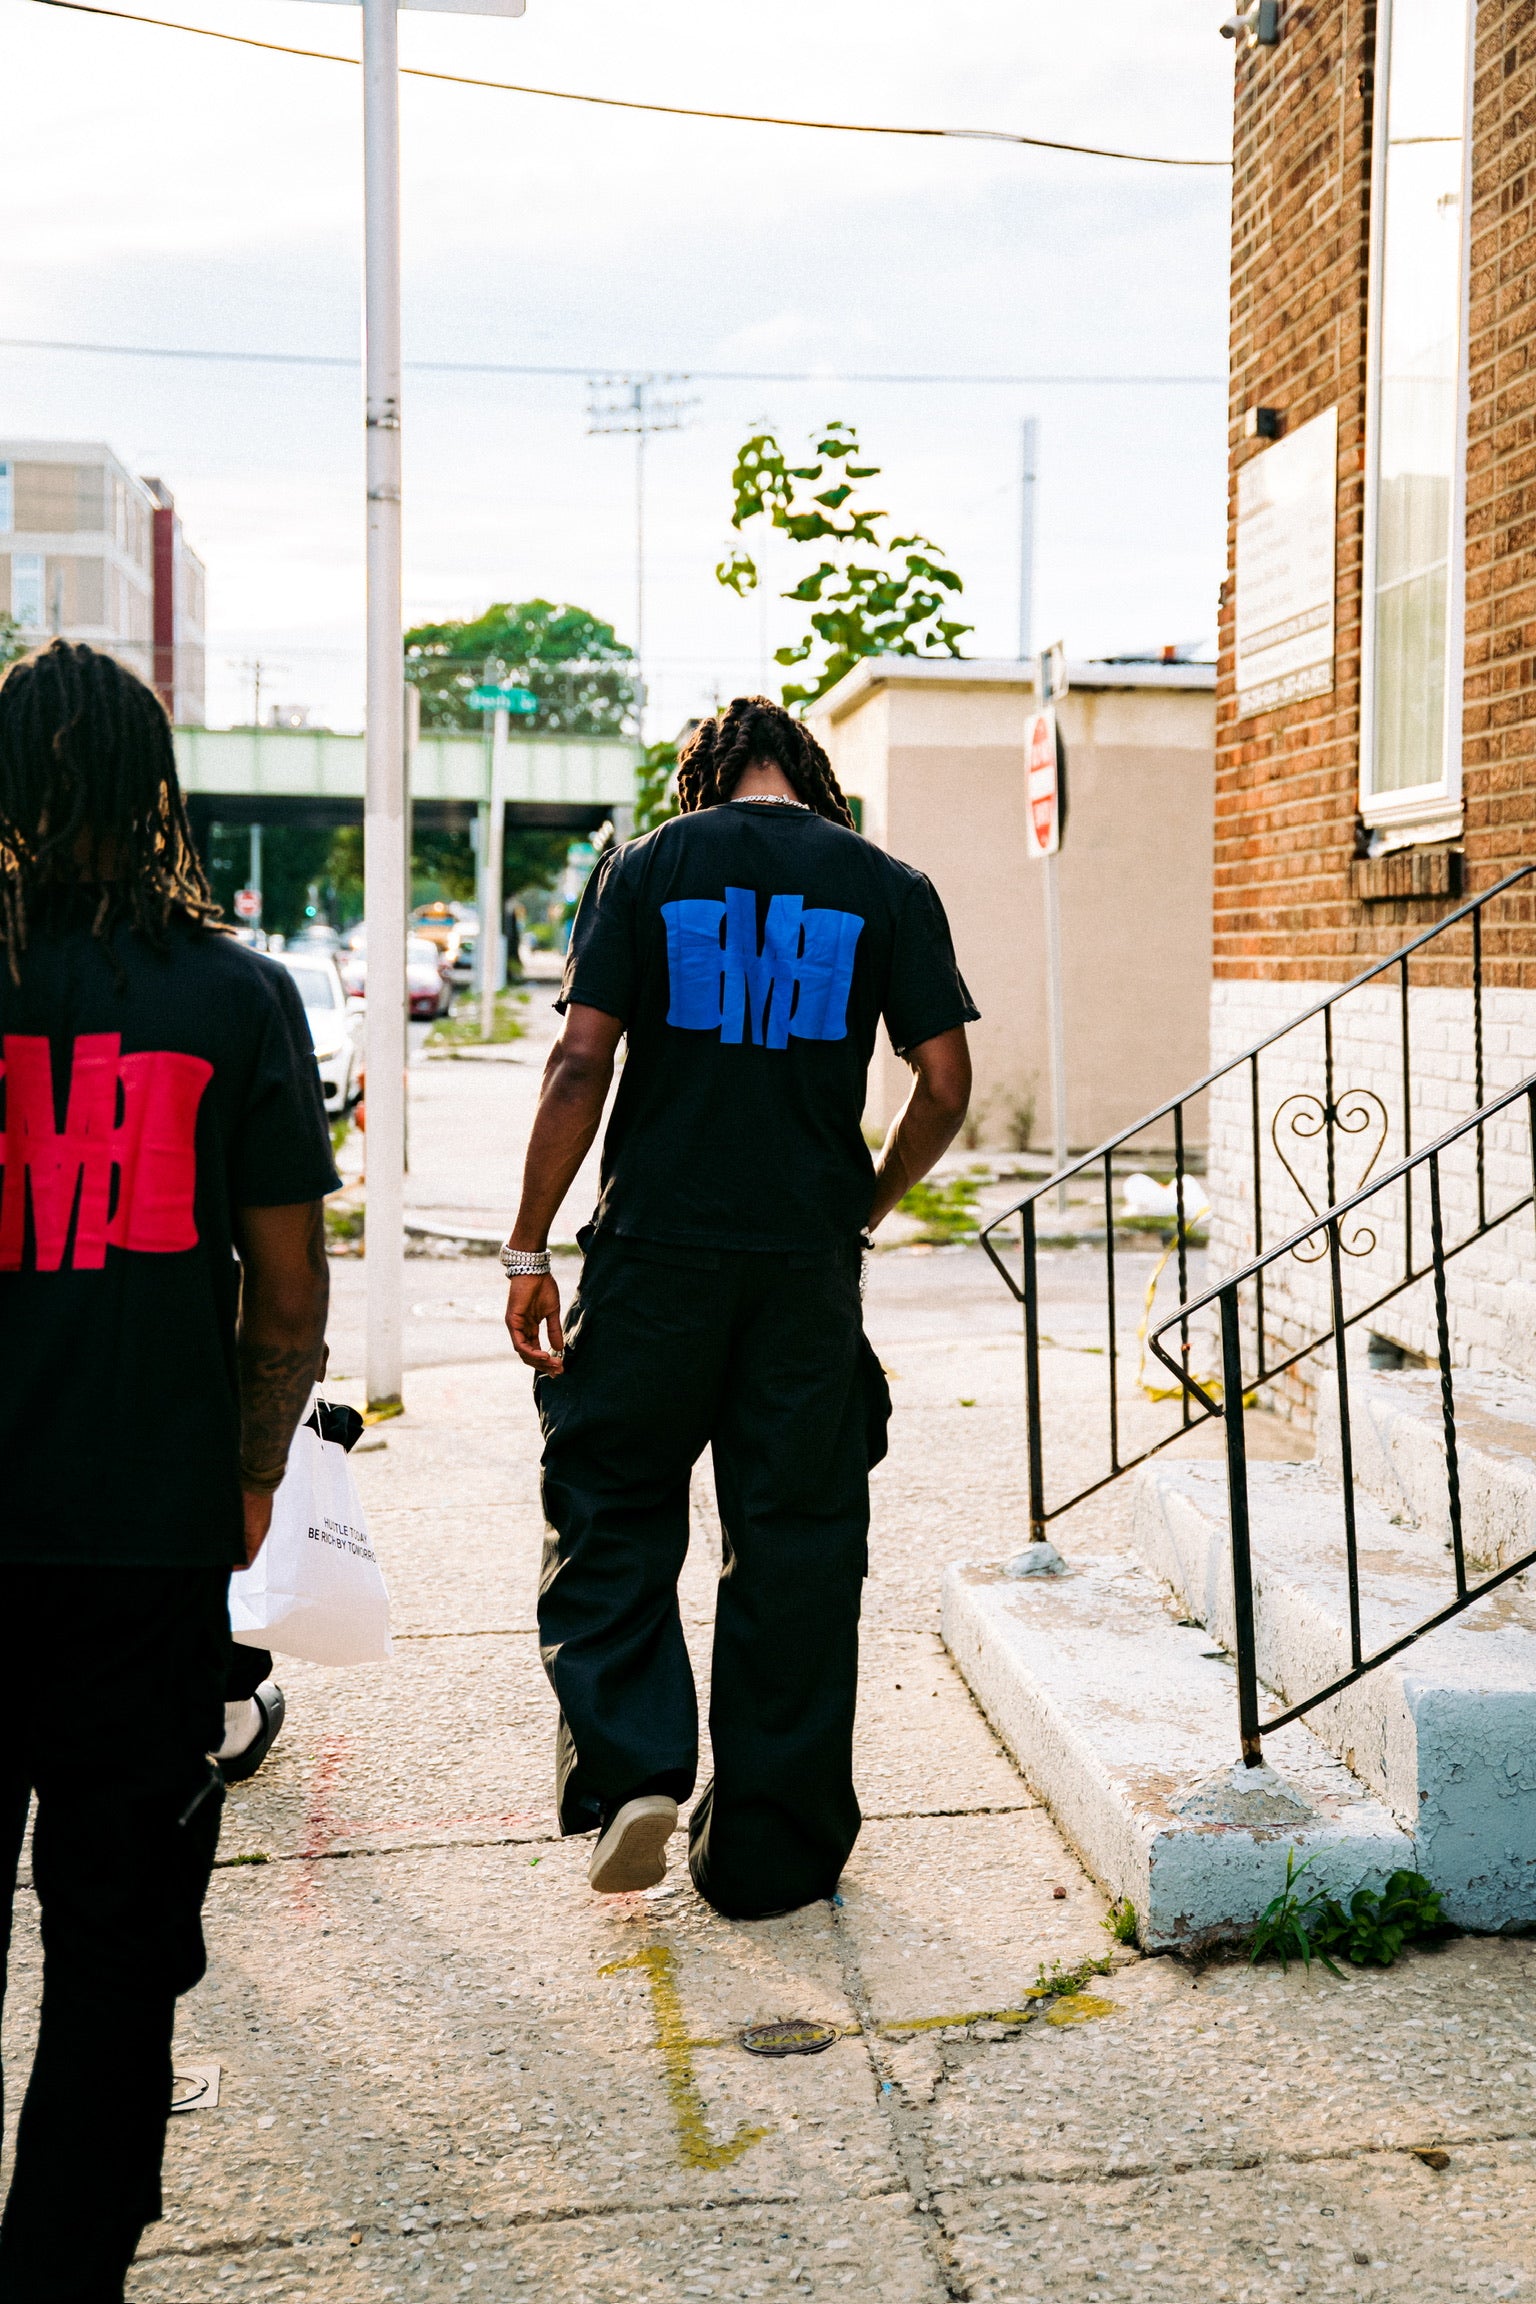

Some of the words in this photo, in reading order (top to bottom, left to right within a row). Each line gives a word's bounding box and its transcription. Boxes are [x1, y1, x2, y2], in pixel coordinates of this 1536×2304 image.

[308, 1527, 320, 1541] BE
[321, 1531, 337, 1546] RICH
[336, 1538, 347, 1550] BY
[347, 1540, 377, 1563] TOMORRO
